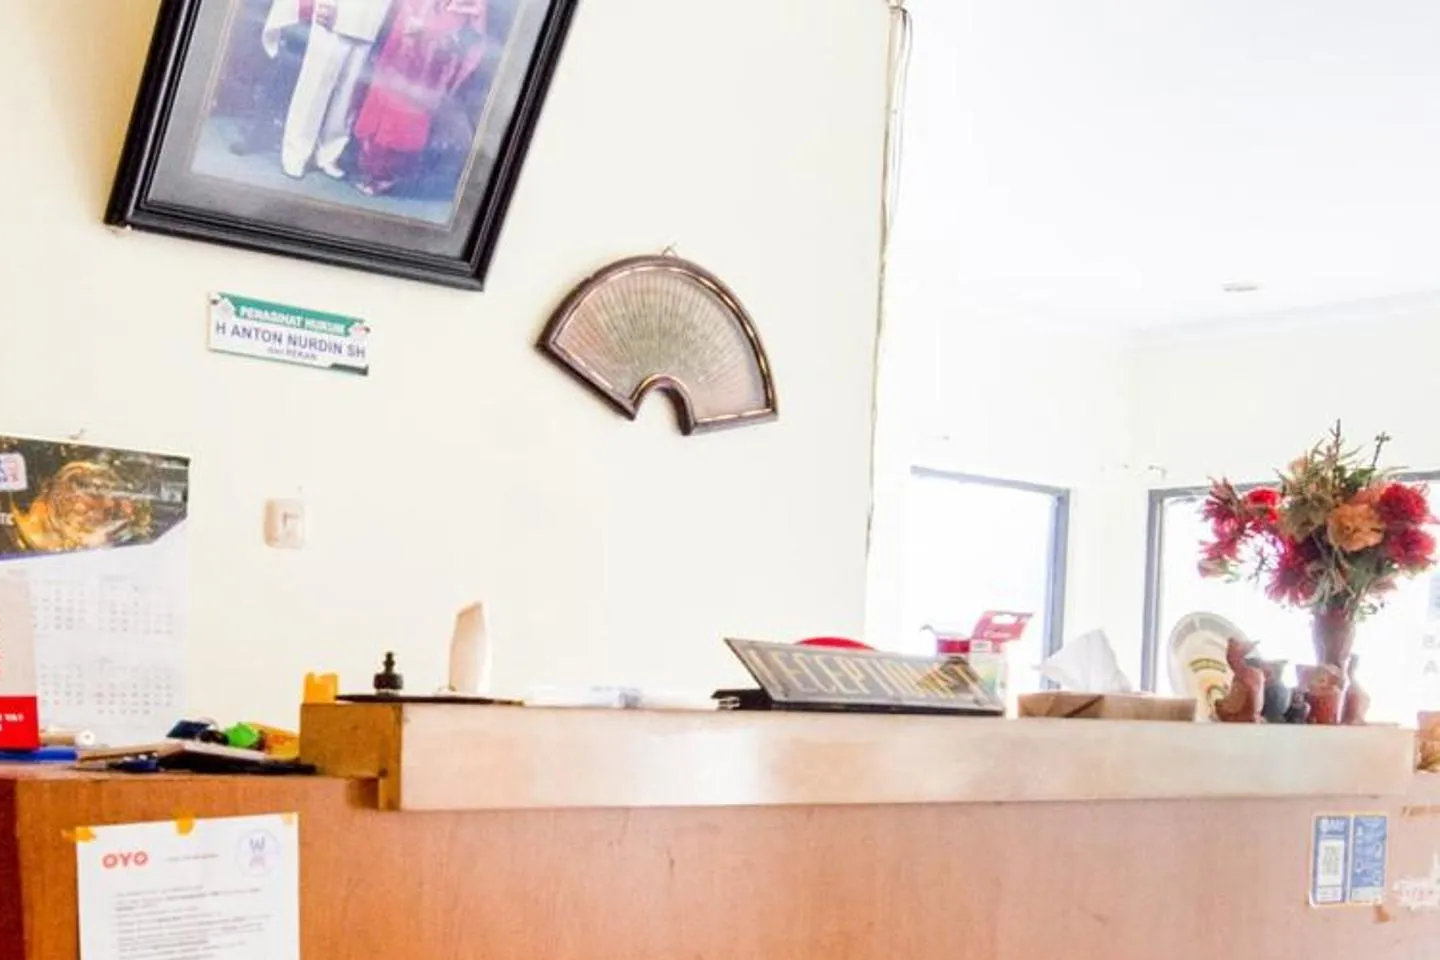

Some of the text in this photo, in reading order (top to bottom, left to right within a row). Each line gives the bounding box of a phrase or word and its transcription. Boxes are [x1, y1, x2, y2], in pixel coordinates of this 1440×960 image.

[216, 322, 366, 359] H ANTON NURDIN SH
[101, 850, 149, 869] OYO
